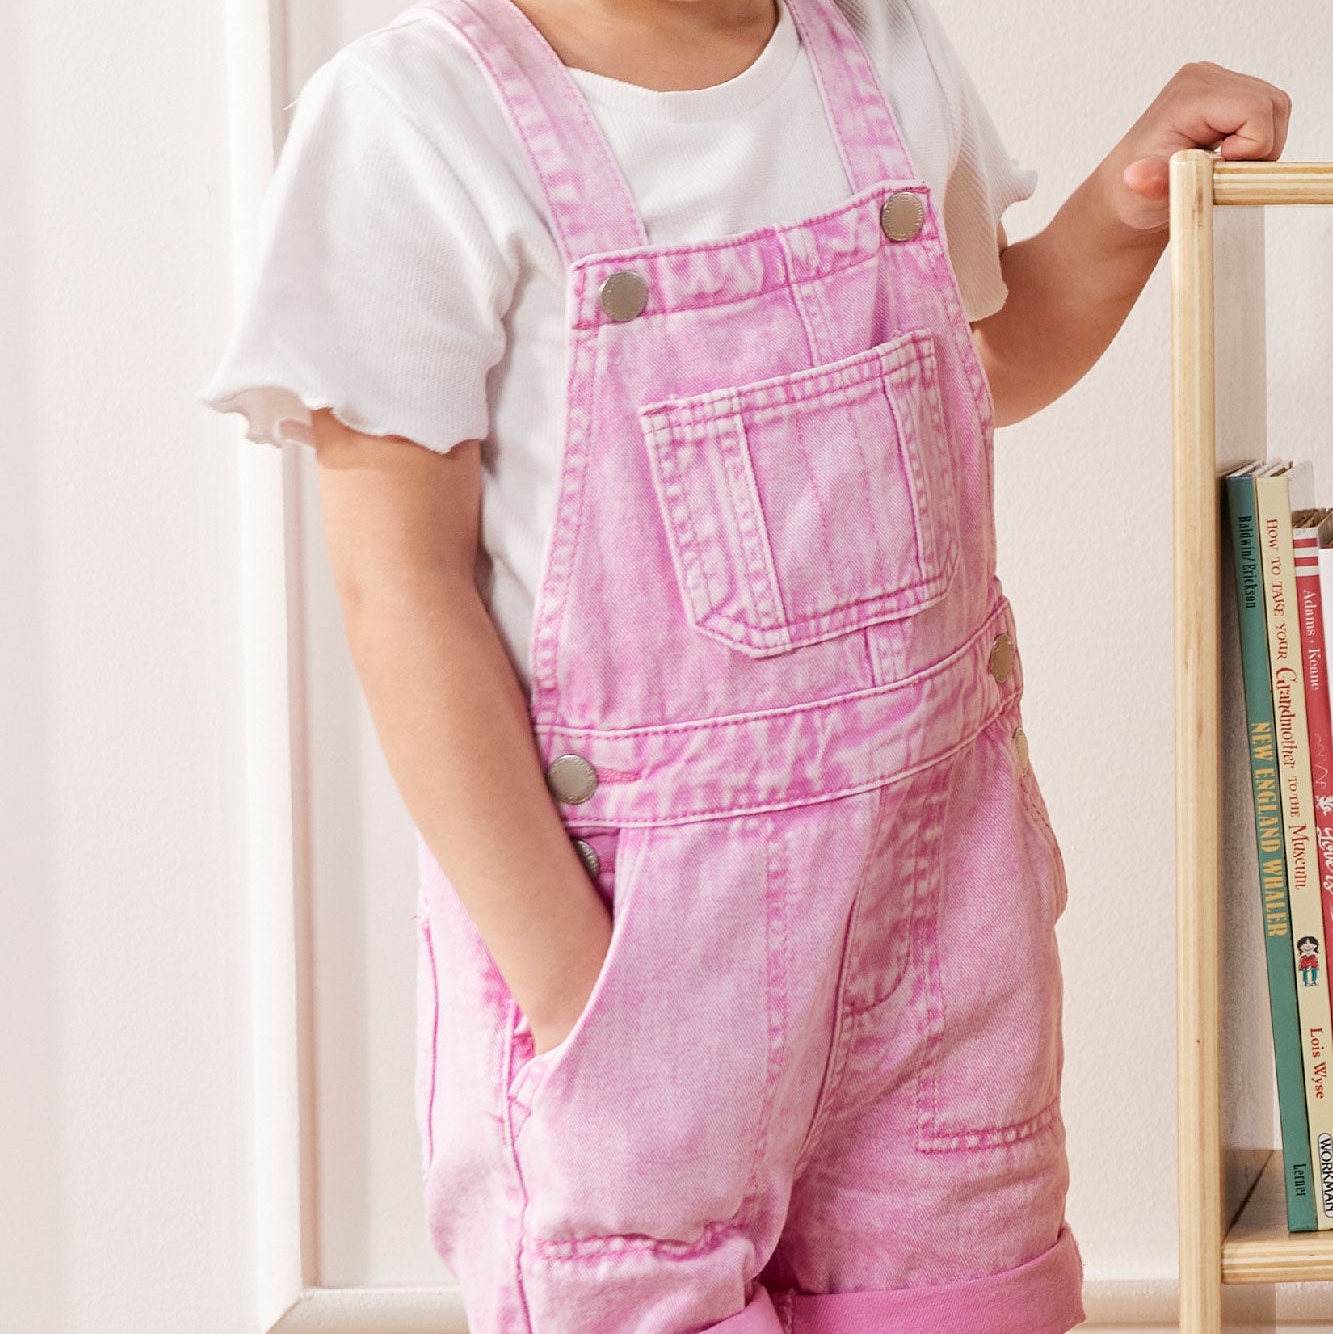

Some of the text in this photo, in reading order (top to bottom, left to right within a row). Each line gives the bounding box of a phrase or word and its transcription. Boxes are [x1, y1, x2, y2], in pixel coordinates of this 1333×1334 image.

[1272, 584, 1285, 616] TAKE
[1303, 590, 1317, 636] Adams
[1276, 623, 1289, 660] YOUR
[1308, 648, 1321, 690] Keane
[1251, 722, 1288, 937] NEW ENGLAND WHALER
[1310, 1027, 1327, 1099] Lois Wyse
[1293, 1163, 1307, 1196] Lerner
